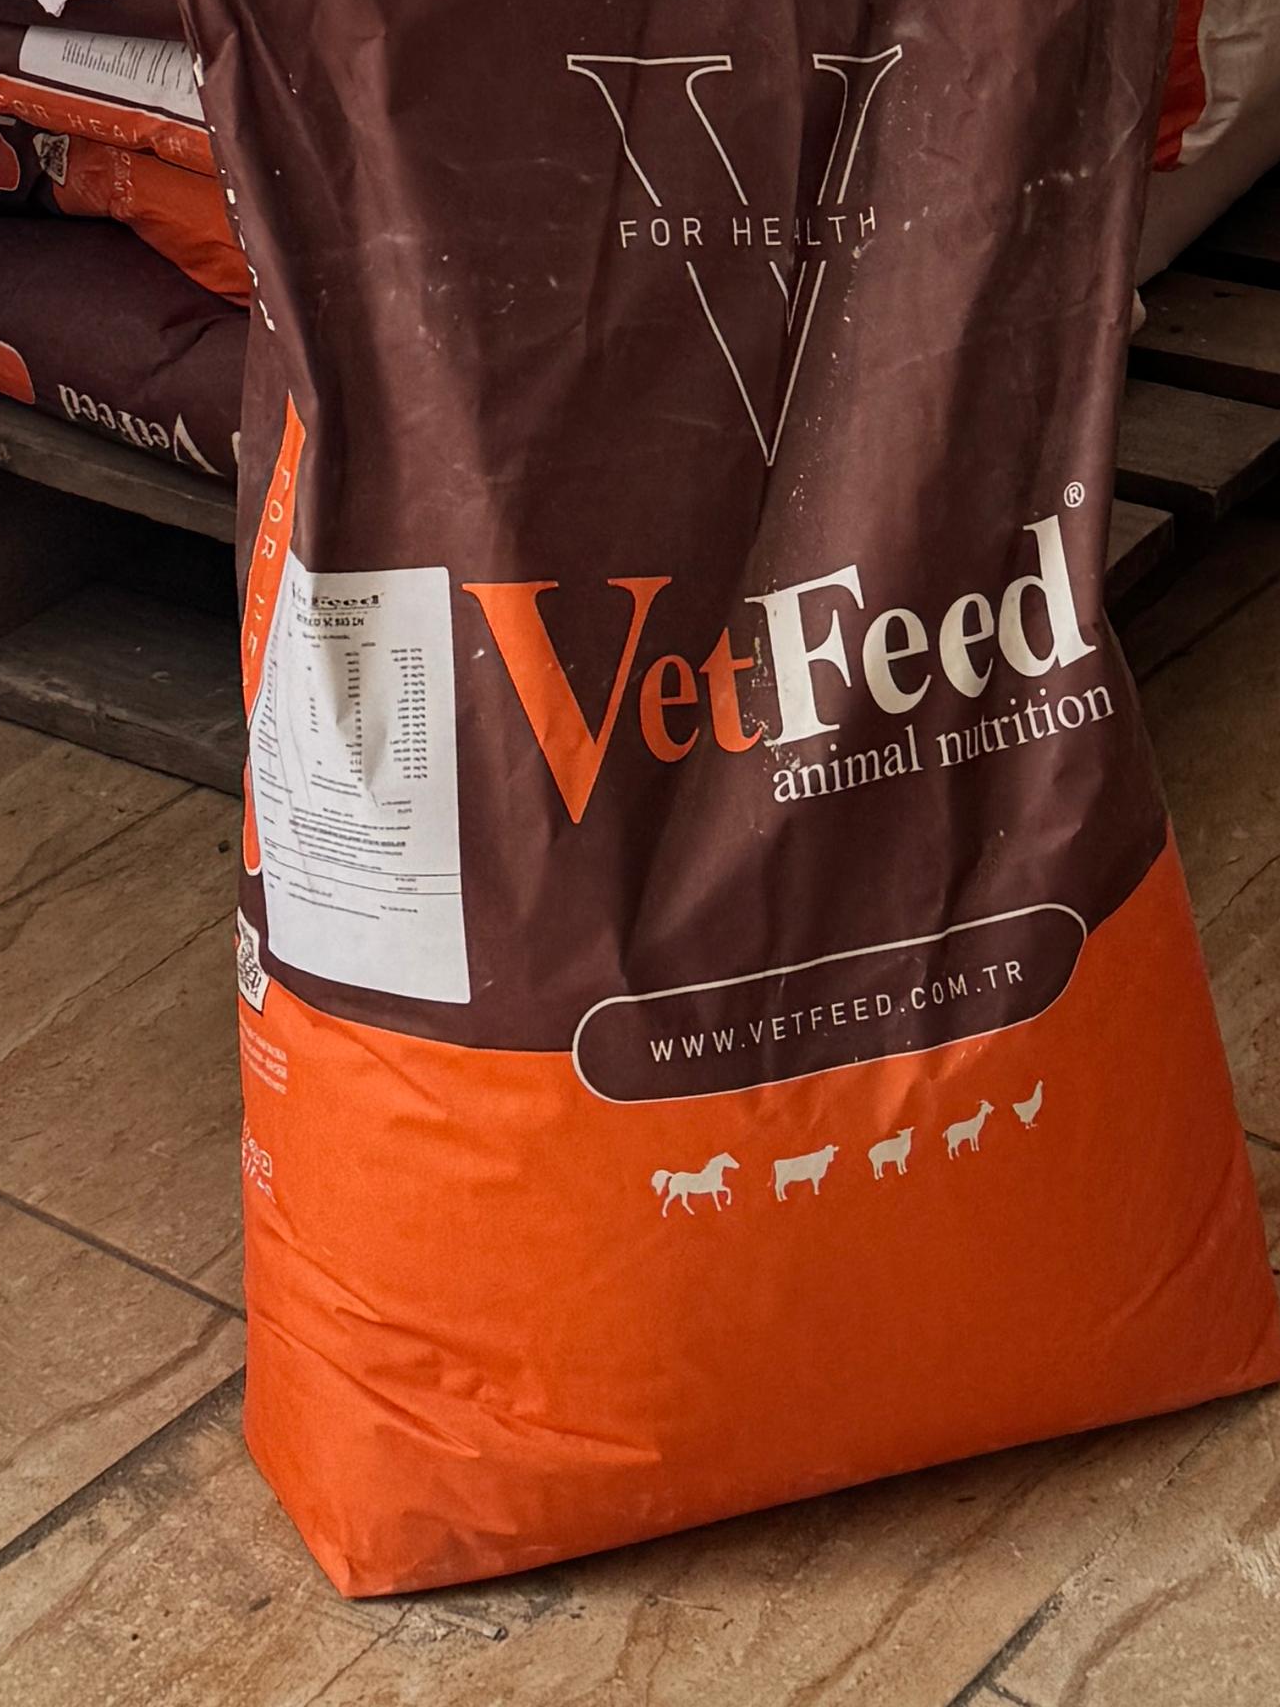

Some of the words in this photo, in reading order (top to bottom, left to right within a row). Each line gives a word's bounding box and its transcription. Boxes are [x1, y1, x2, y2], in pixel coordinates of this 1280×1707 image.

[619, 217, 703, 249] FOR
[731, 205, 875, 247] HELTH
[463, 515, 1097, 824] VetFeed
[772, 725, 919, 804] animal
[938, 679, 1115, 766] nutrition
[650, 957, 1026, 1065] WWW.VETFEED.COM.TR
